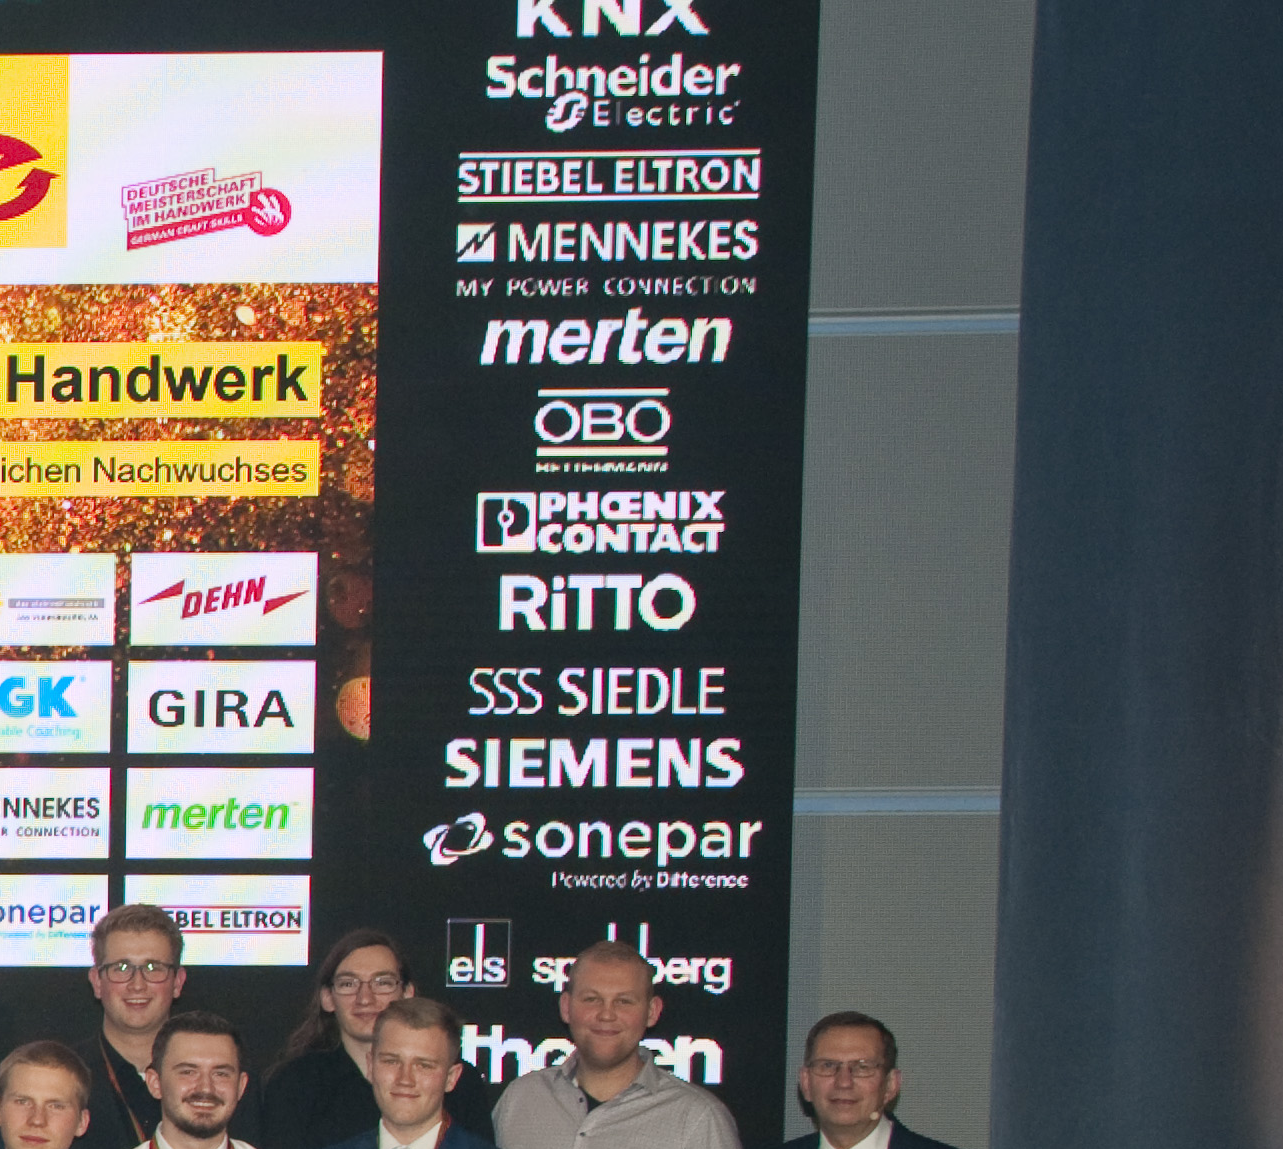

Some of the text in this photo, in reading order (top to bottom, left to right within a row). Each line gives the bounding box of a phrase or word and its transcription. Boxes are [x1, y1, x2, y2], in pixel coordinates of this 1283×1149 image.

[517, 0, 710, 36] KNX
[487, 53, 741, 98] Schneider
[593, 101, 737, 127] Electric
[127, 172, 210, 203] DEUTSCHE
[458, 157, 760, 194] STIEBEL ELTRON
[129, 176, 257, 216] MEISTERSCHAFT
[154, 191, 246, 224] HANDWERK
[508, 220, 759, 263] MENNEKES
[456, 277, 756, 297] MY POWER CONNECTION
[479, 306, 733, 366] merten
[534, 400, 671, 443] OBO
[93, 456, 308, 486] Nachwuchses
[536, 522, 724, 552] CONTACT
[181, 575, 267, 620] DEHN
[149, 690, 295, 728] GIRA
[558, 668, 725, 715] SIEDLE
[445, 738, 745, 788] SIEMENS
[16, 827, 100, 837] CONNECTION
[141, 798, 289, 830] merten
[501, 818, 763, 866] sonepar
[220, 910, 302, 928] ELTRON
[450, 923, 732, 993] els spberg
